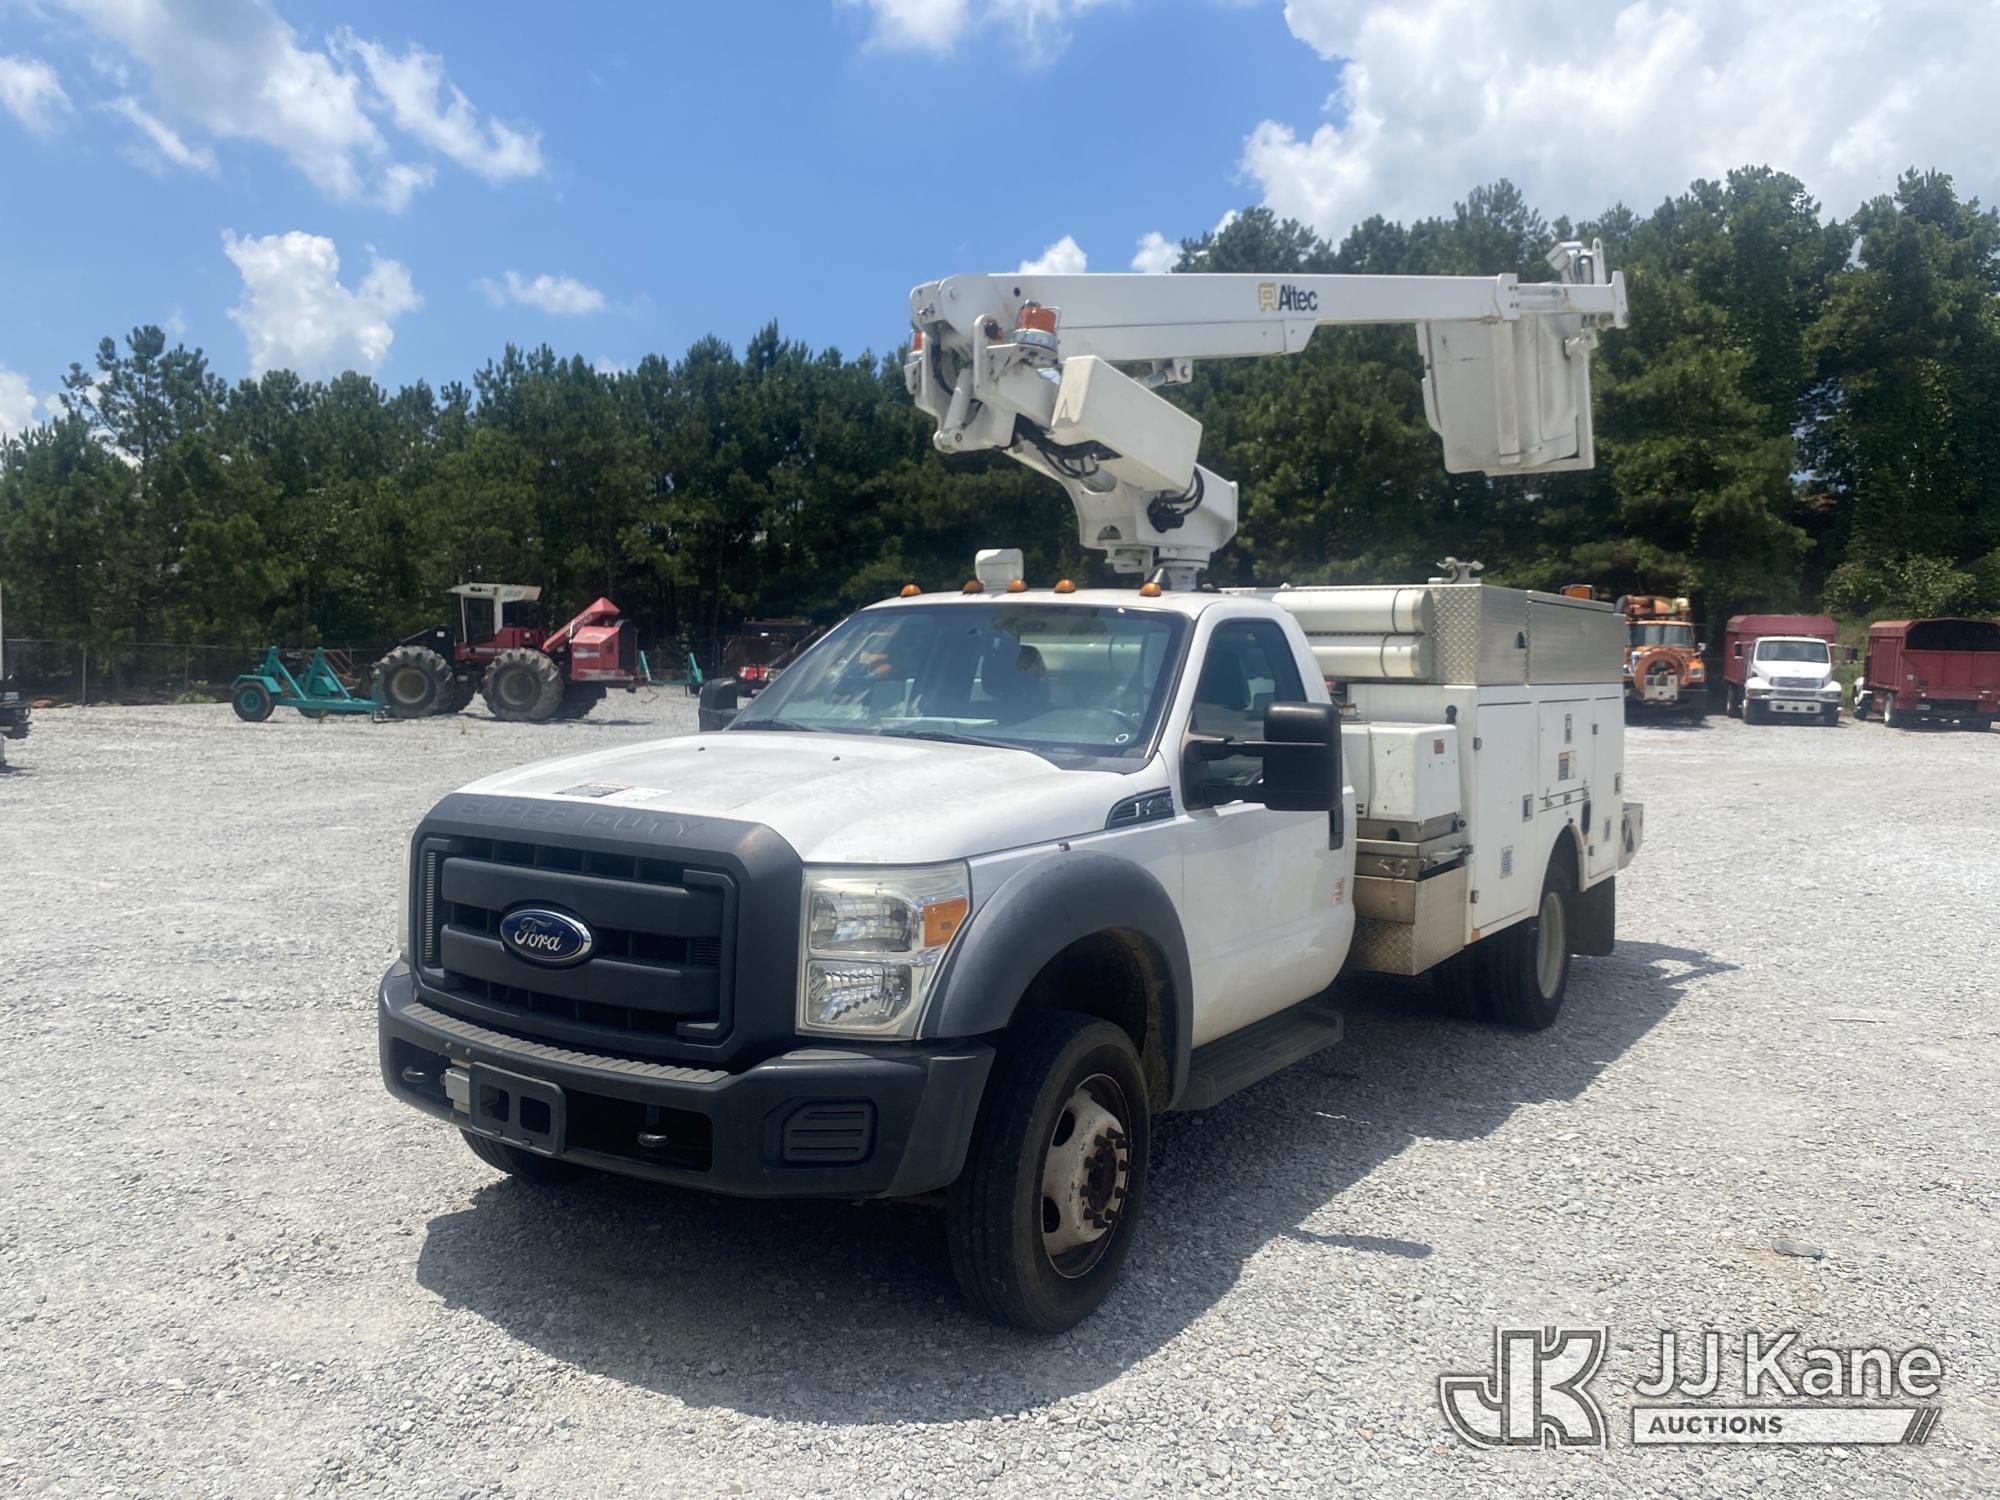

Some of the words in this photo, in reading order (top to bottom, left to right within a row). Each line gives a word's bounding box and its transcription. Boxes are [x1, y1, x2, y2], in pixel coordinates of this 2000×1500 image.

[1278, 284, 1319, 312] Altec
[456, 802, 574, 825] SUPER
[583, 810, 705, 839] DUTY
[514, 916, 564, 952] Ford
